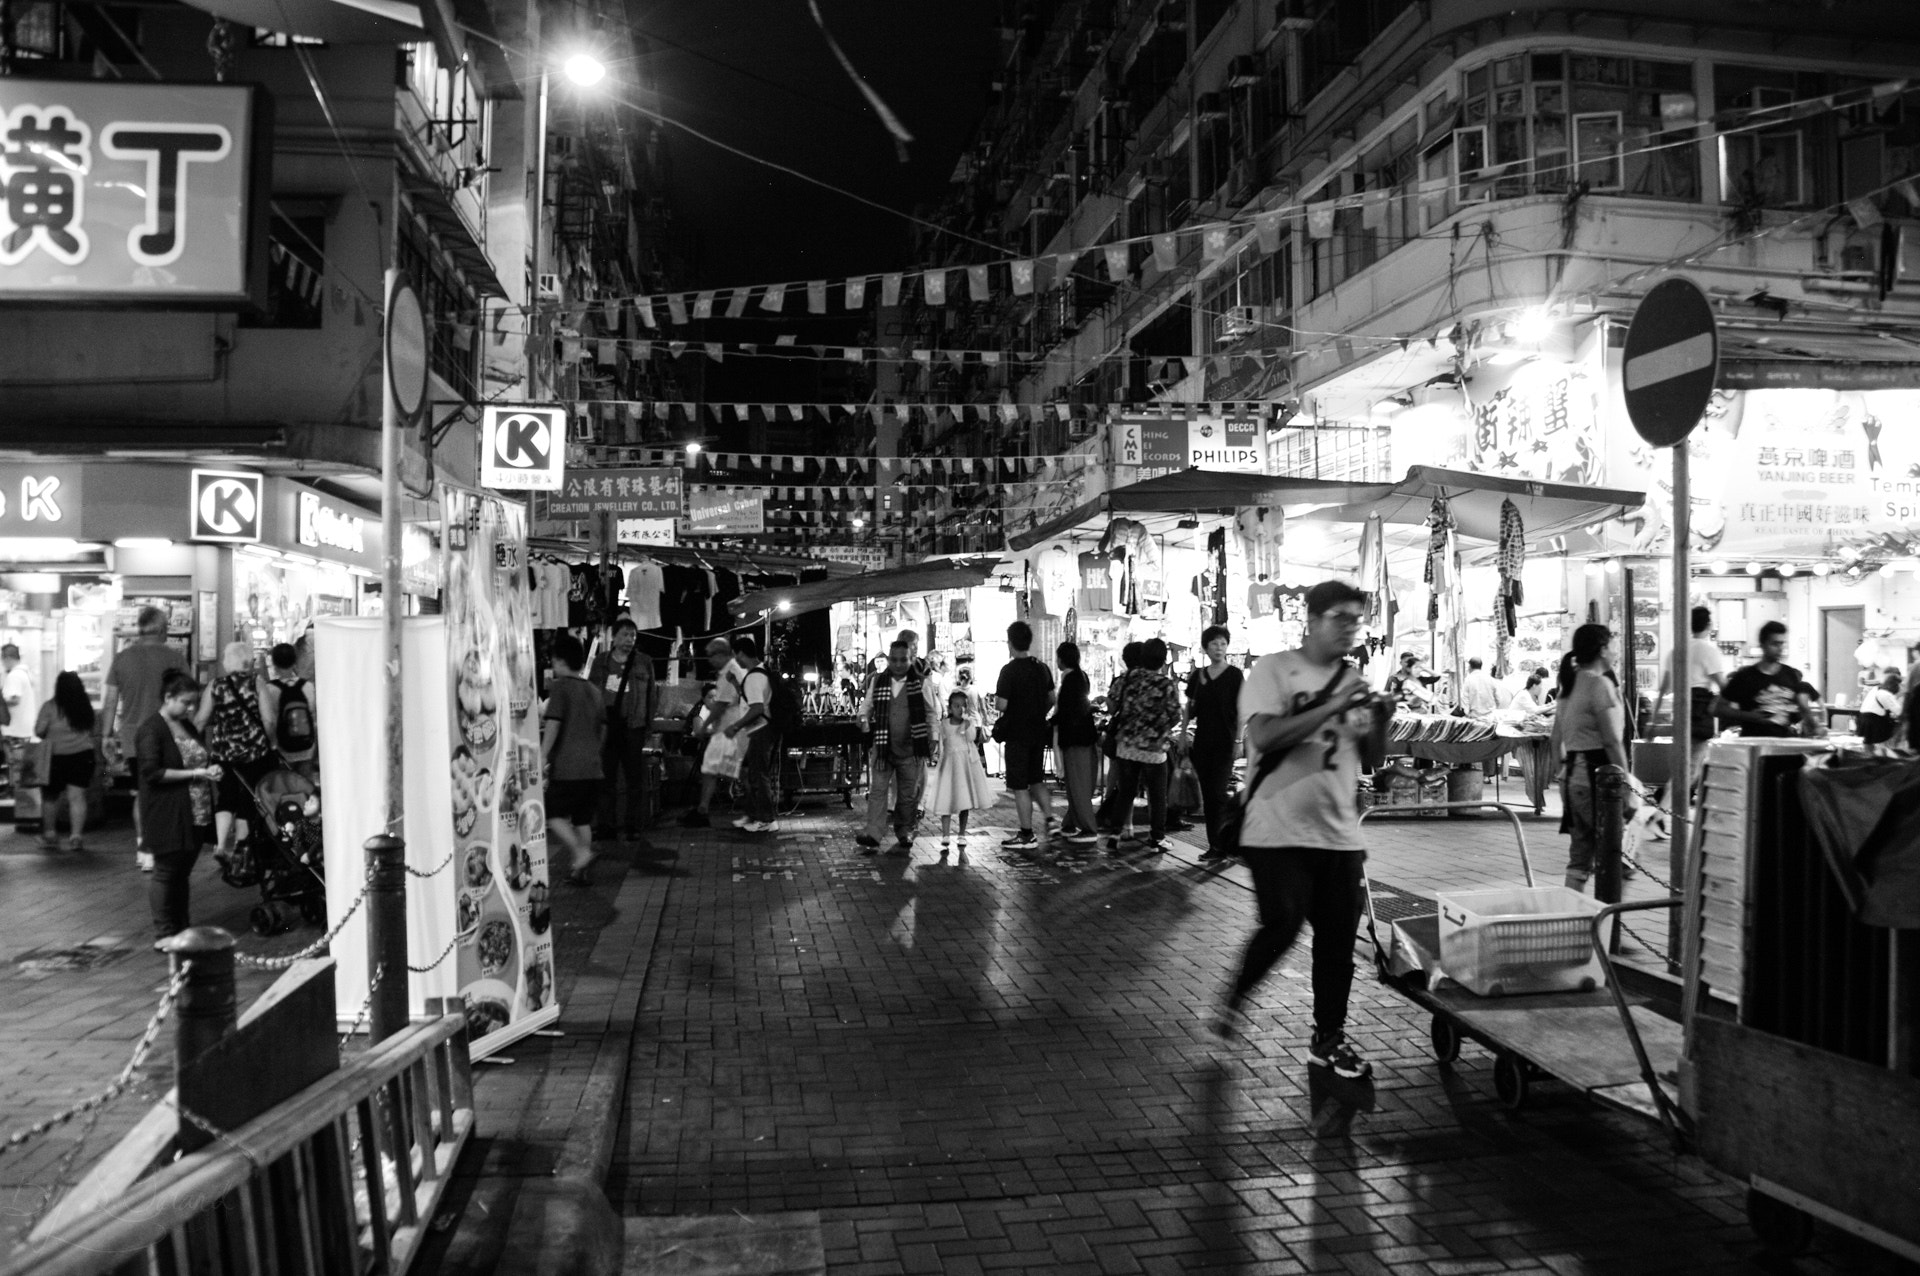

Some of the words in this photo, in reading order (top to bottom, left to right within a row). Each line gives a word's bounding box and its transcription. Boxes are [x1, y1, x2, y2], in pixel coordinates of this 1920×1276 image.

[1227, 423, 1256, 433] DECCA
[1193, 450, 1258, 464] PHILIPS
[1758, 446, 1856, 469] 燕京啤酒
[1757, 470, 1816, 484] YANJING
[1819, 472, 1856, 485] BEER
[550, 502, 590, 514] CREATION
[661, 500, 679, 511] LTD.
[690, 502, 731, 522] Universal
[1827, 528, 1856, 538] HINA
